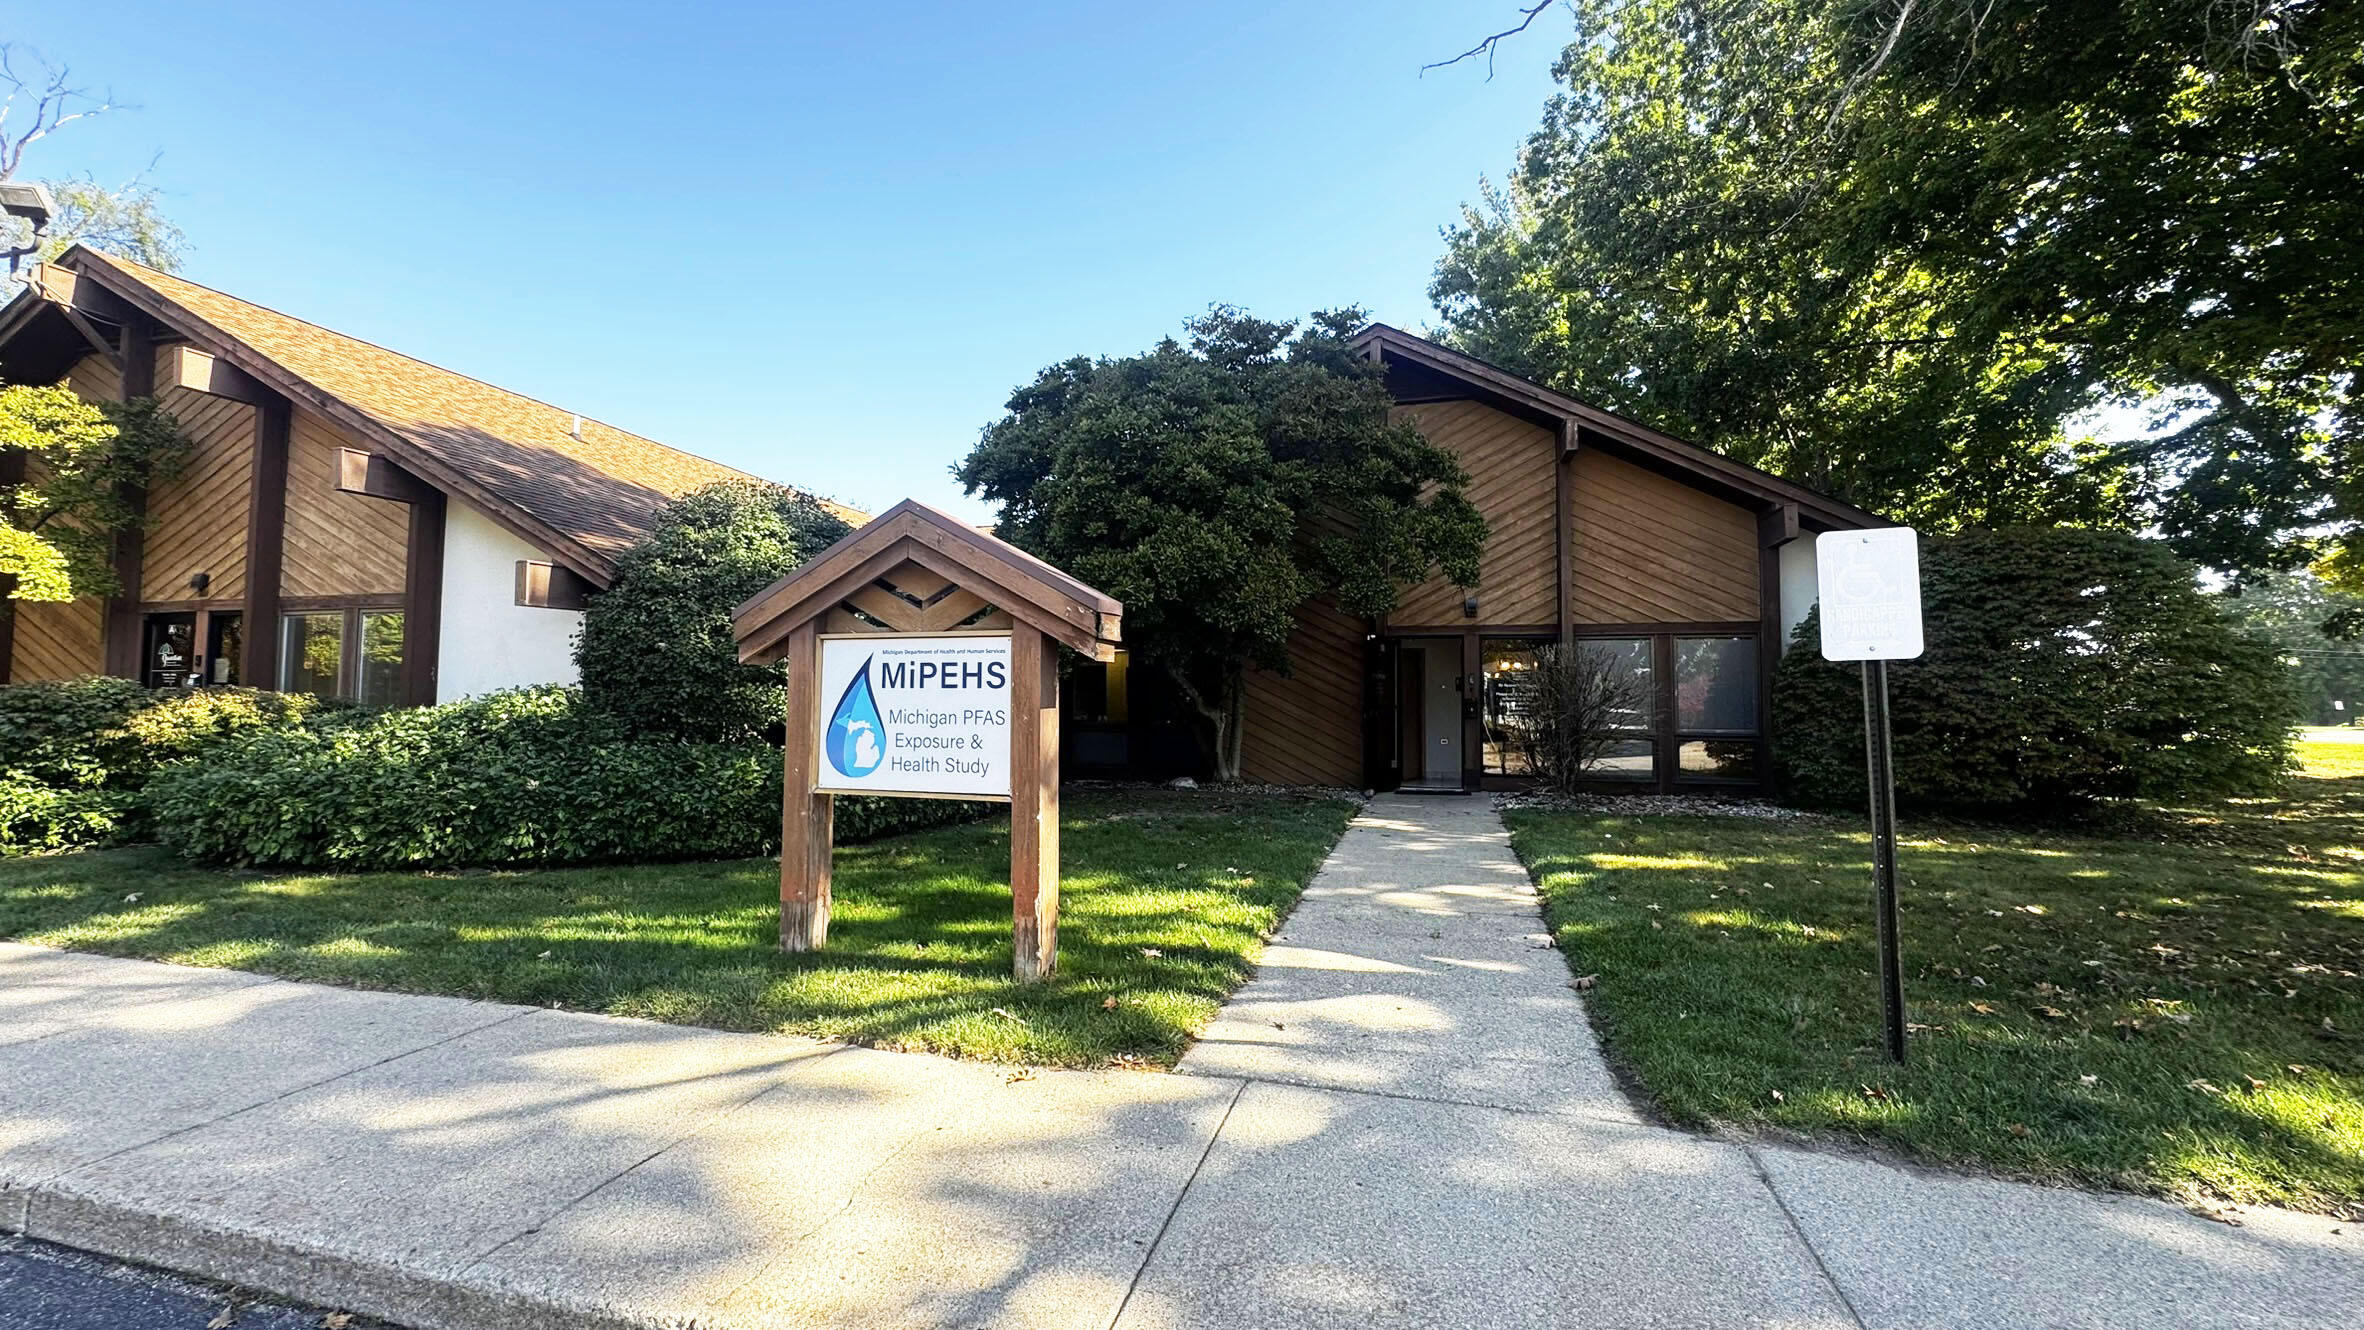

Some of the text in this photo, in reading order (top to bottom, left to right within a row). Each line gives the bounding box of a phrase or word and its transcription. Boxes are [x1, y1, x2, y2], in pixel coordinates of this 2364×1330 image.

[881, 660, 1006, 689] MiPEHS
[889, 708, 1006, 729] Michigan PFAS
[895, 732, 983, 751] Exposure &
[891, 756, 990, 778] Health Study
